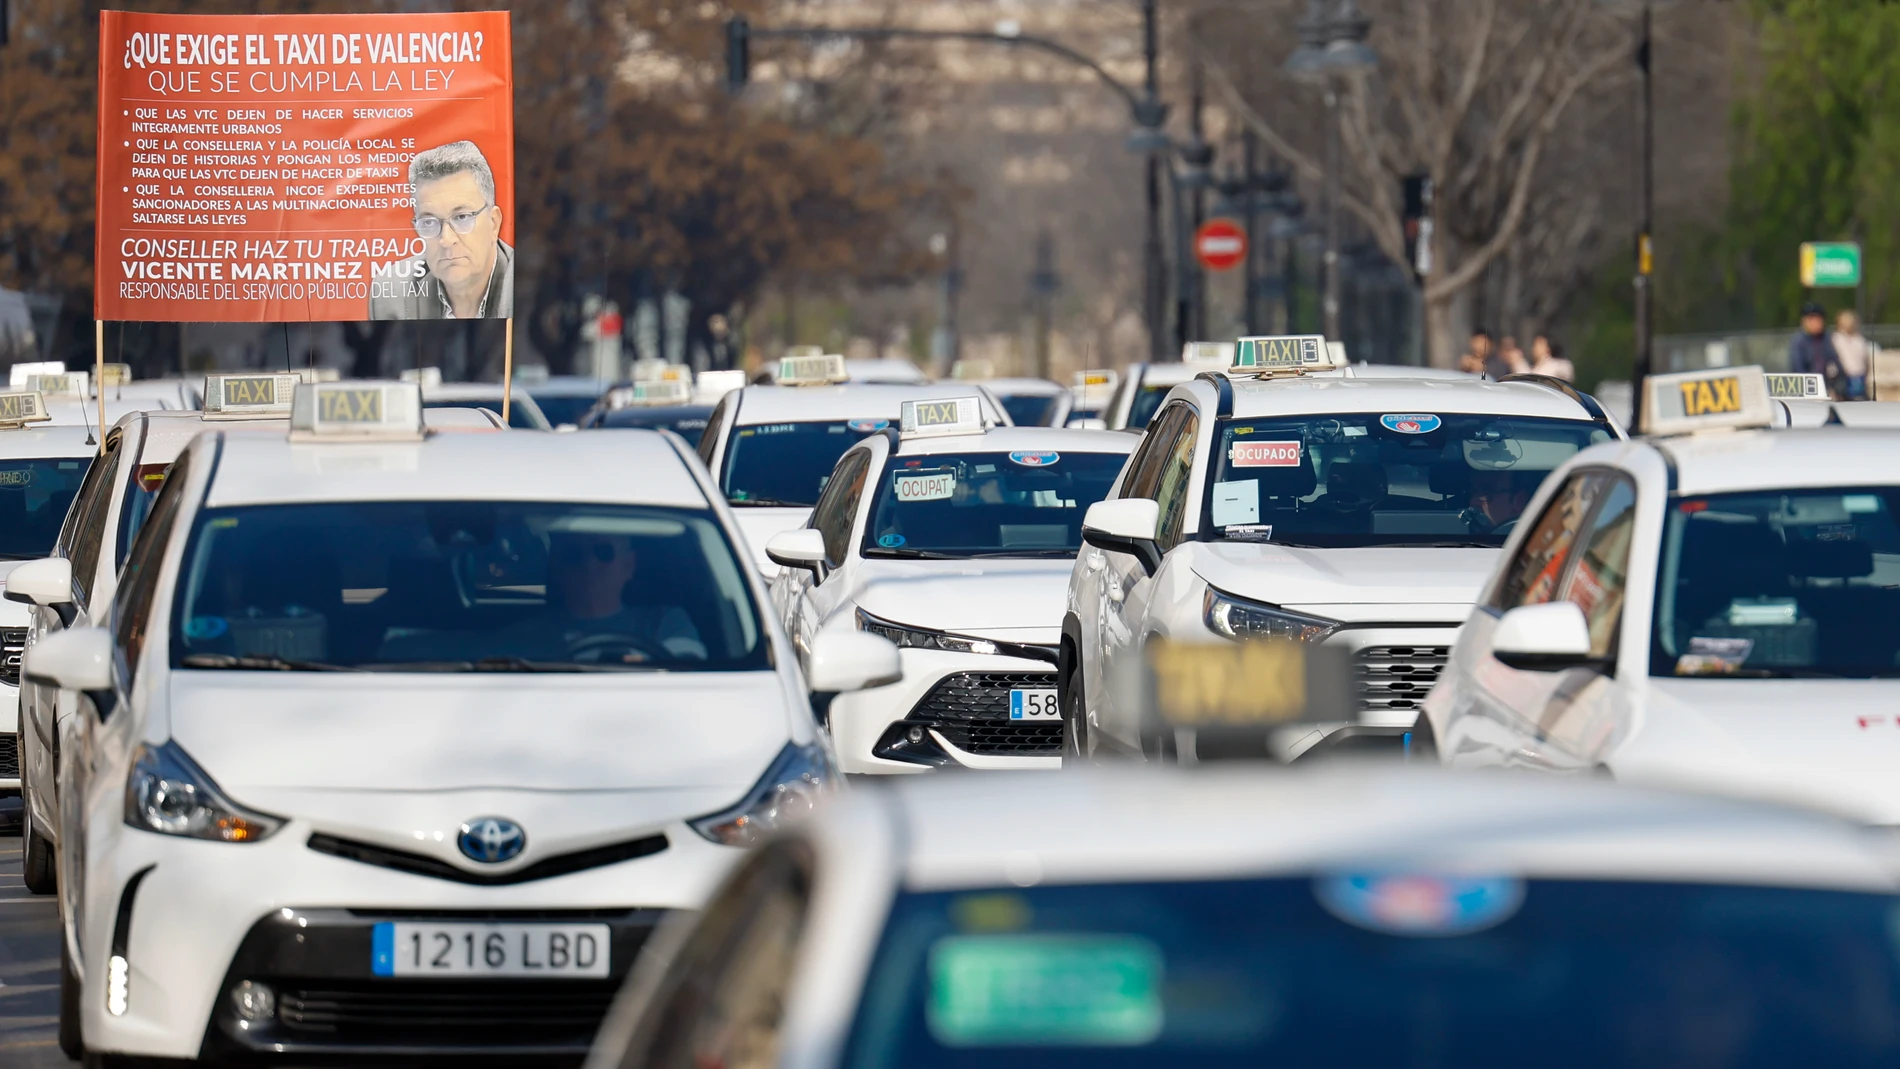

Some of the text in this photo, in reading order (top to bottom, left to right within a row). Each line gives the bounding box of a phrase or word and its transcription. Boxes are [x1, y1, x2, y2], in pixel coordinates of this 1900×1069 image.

[123, 31, 483, 69] ¿QUE EXIGE EL TAXI DE VALENCIA?
[148, 69, 455, 95] QUE SE CUMPLA LA LEY
[135, 108, 413, 120] QUE LAS VTC DEJEN DE HACER SERVICIOS
[132, 122, 282, 134] INTEGRAMENTE URBANOS
[136, 138, 415, 151] QUE LA CONSELLERIA Y LA POLICÍA LOCAL SE
[132, 153, 415, 165] DEJEN DE HISTORIAS Y PONGAN LOS MEDIOS
[132, 168, 399, 180] PARA QUE LAS VTC DEJEN DE HACER DE TAXIS
[136, 184, 417, 196] QUE LA CONSELLERIA INCOE EXPEDIENTES
[132, 198, 417, 210] SANCIONADORES A LAS MULTINACIONALES POR
[133, 213, 247, 224] SALTARSE LAS LEYES
[121, 237, 427, 259] CONSELLER HAZ TU TRABAJO
[121, 260, 426, 280] VICENTE MARTINEZ MUS
[120, 278, 429, 300] RESPONSABLE DEL SERVICIO PÚBLICO DEL TAXI
[1258, 340, 1299, 361] TAXI
[225, 380, 273, 403] TAXI
[1769, 376, 1802, 393] TAXI
[319, 391, 382, 421] TAXI
[1680, 378, 1741, 416] TAXI
[918, 402, 957, 425] TAXI
[1235, 446, 1297, 462] OCUPADO
[902, 478, 949, 498] OCUPAT
[1029, 694, 1057, 716] 58
[410, 931, 597, 970] 1216 LBD
